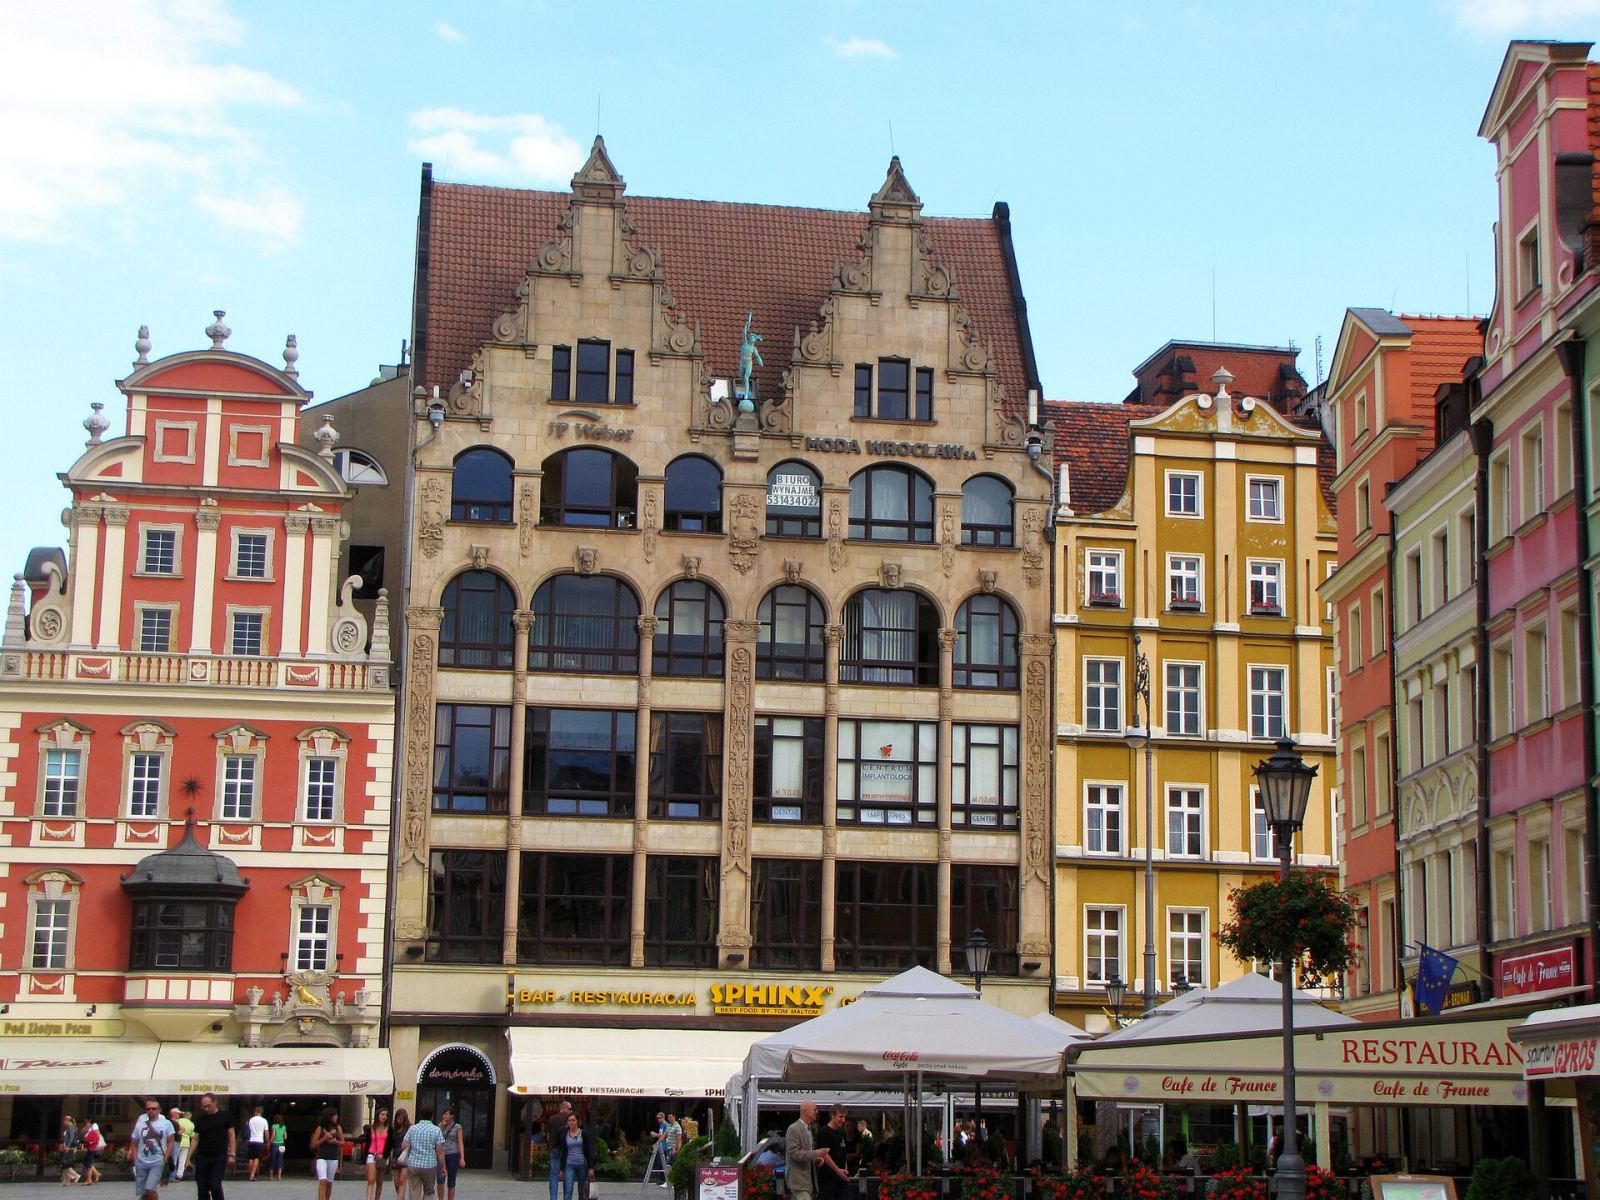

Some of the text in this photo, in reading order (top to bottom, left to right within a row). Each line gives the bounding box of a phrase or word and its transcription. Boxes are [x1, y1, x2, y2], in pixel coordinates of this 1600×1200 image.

[575, 422, 634, 442] Weber
[805, 436, 861, 455] MODA
[777, 475, 810, 485] BIURO
[767, 494, 819, 506] 531434027
[773, 808, 800, 817] DENTAL
[972, 814, 997, 822] CENTER
[519, 990, 557, 1003] BAR
[571, 991, 697, 1005] RESTAURACJA
[711, 983, 826, 1007] SPHINX
[4, 1022, 25, 1034] Pod
[1555, 1039, 1597, 1073] GYROS
[548, 1086, 583, 1094] SPHINX
[1161, 1076, 1194, 1095] Cafe
[1201, 1076, 1217, 1092] de
[1225, 1076, 1278, 1096] France
[1373, 1080, 1490, 1100] Cafe de France
